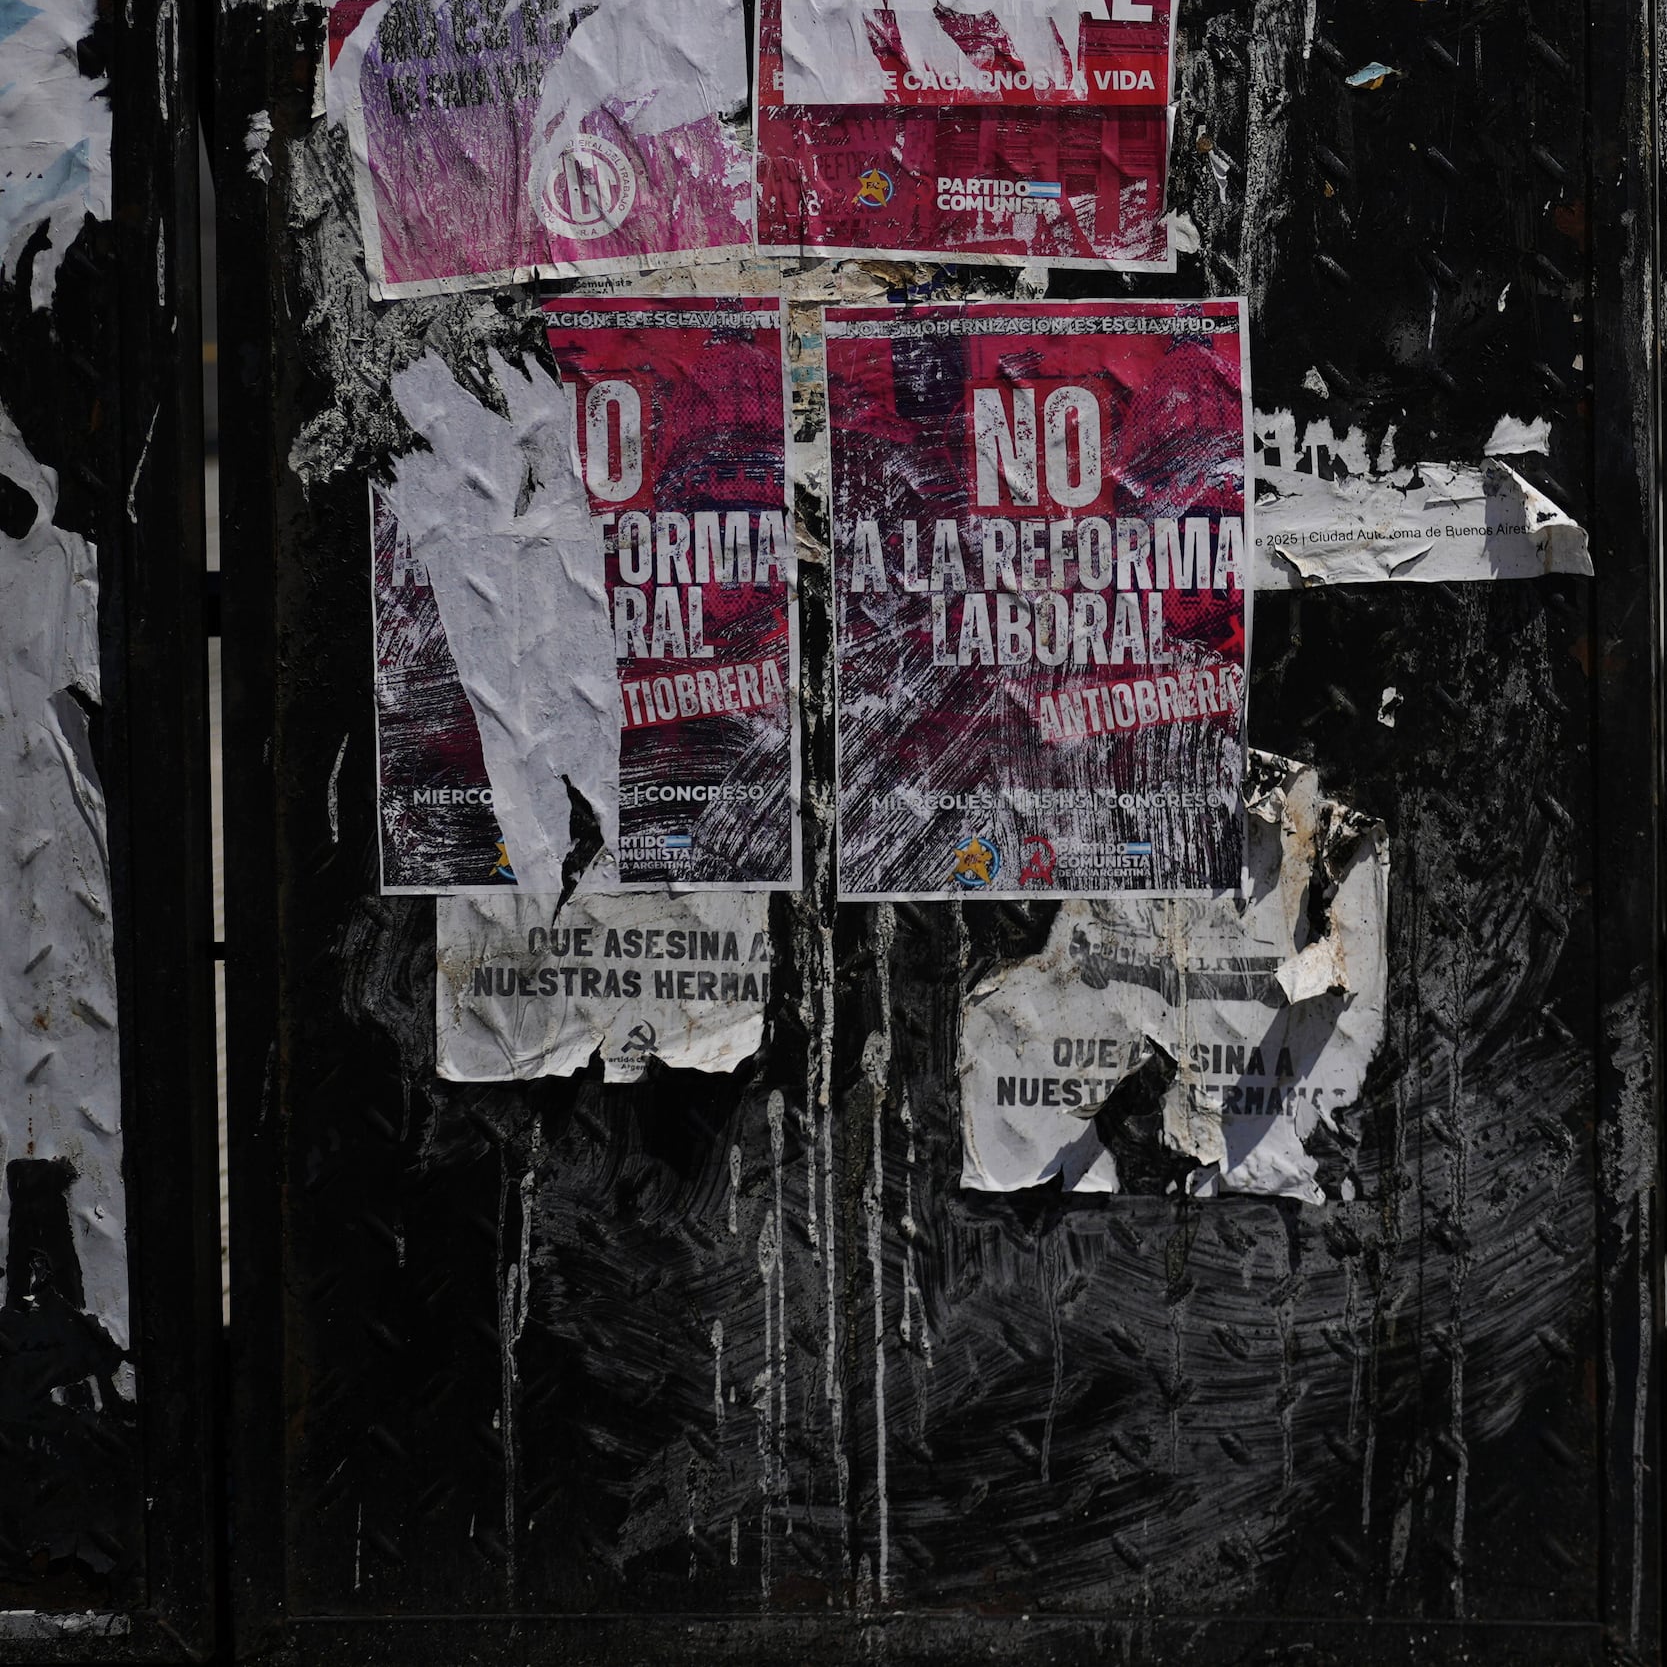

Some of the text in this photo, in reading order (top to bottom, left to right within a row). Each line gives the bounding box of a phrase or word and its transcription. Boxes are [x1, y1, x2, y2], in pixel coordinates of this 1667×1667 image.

[903, 69, 1155, 91] CAGARNOS LA VIDA
[938, 178, 1031, 196] PARTIDO
[938, 196, 1061, 213] COMUNISTA
[972, 385, 1102, 509] NO
[1267, 524, 1527, 546] 2025 Ciudad de Buenos Aires
[852, 517, 1246, 594] A LA REFORMA
[932, 593, 1171, 666] LABORAL
[1039, 672, 1239, 738] ANTIOBRERA
[645, 786, 764, 801] CONGRESO
[1057, 844, 1127, 855] PARTIDO
[632, 860, 690, 870] ARGENTINA
[1057, 855, 1150, 868] COMUNISTA
[528, 927, 739, 961] QUE ASESINA
[474, 966, 642, 998] NUESTRAS
